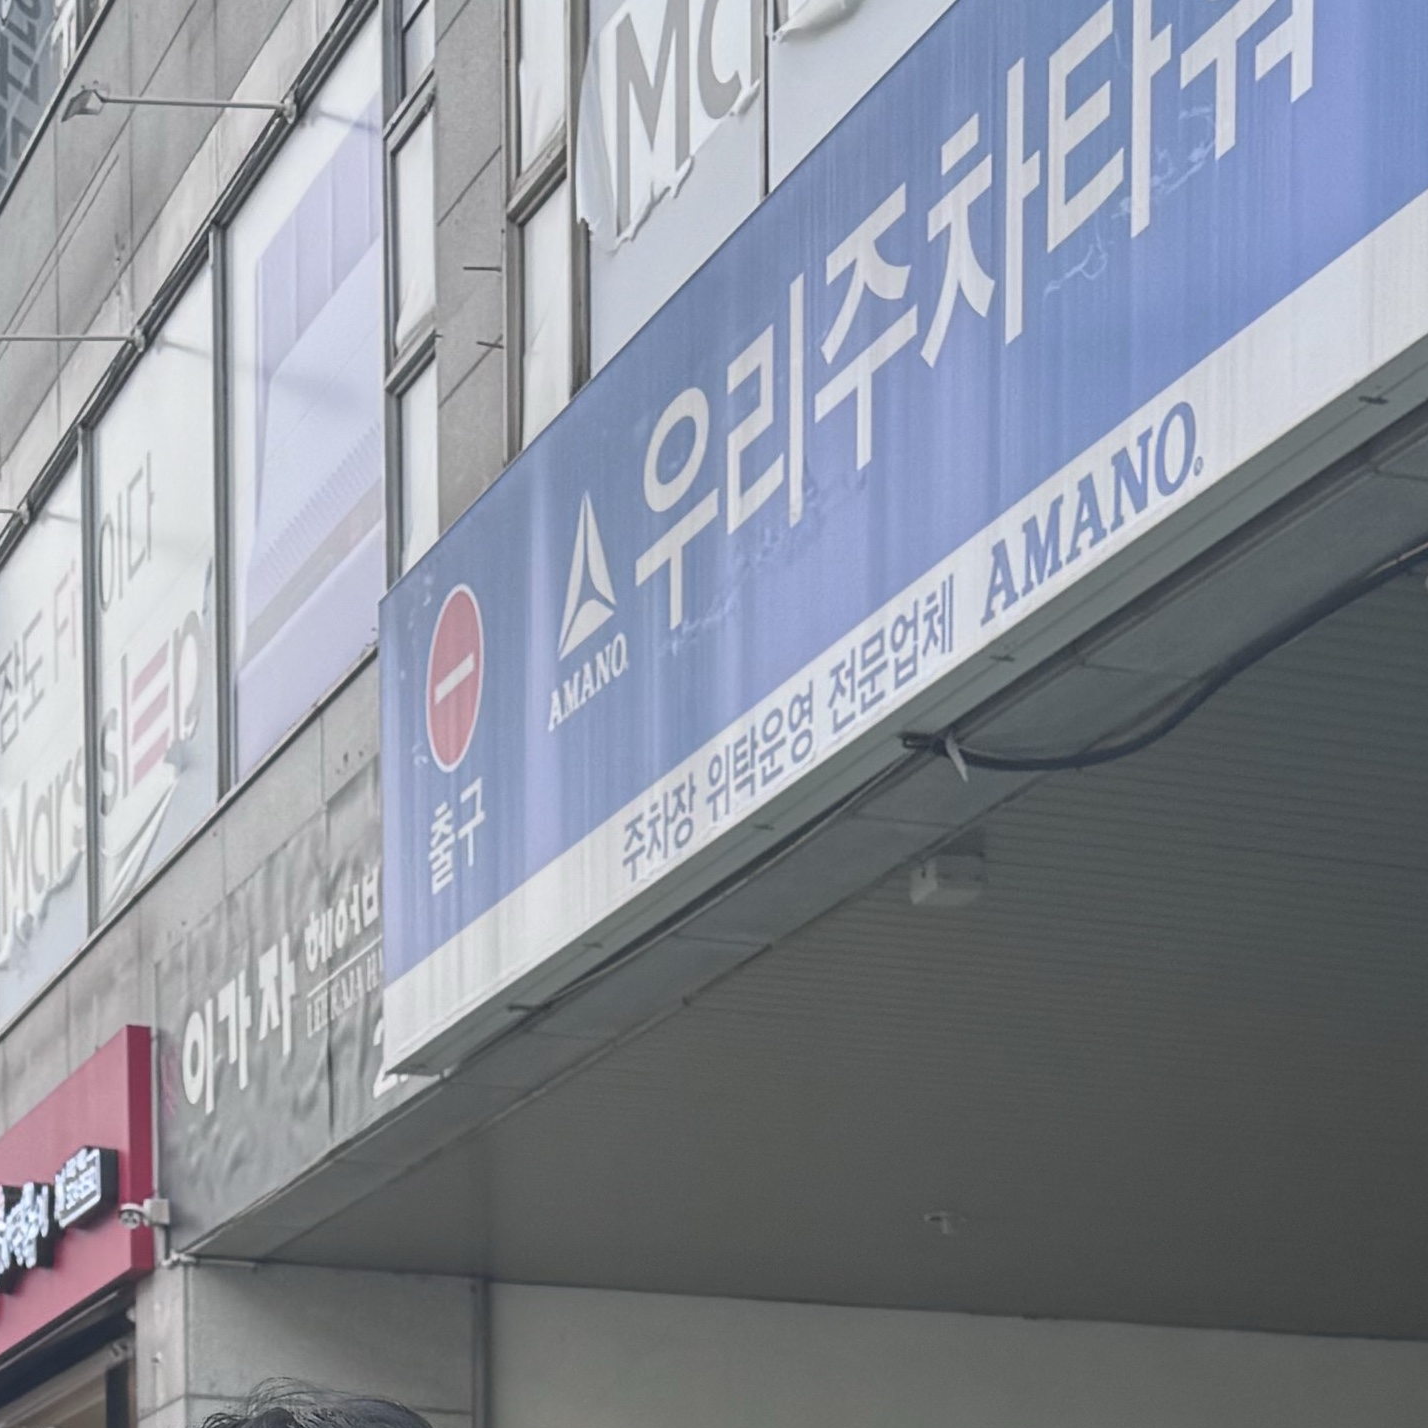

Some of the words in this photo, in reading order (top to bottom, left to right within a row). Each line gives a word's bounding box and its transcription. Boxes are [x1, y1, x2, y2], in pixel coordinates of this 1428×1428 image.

[548, 632, 627, 732] AMANO
[623, 772, 696, 882] 주차장
[706, 680, 813, 822] 위탁운영
[828, 573, 954, 734] 전문업체
[980, 401, 1196, 627] AMANO
[429, 776, 485, 894] 출구
[182, 934, 296, 1115] 이가자
